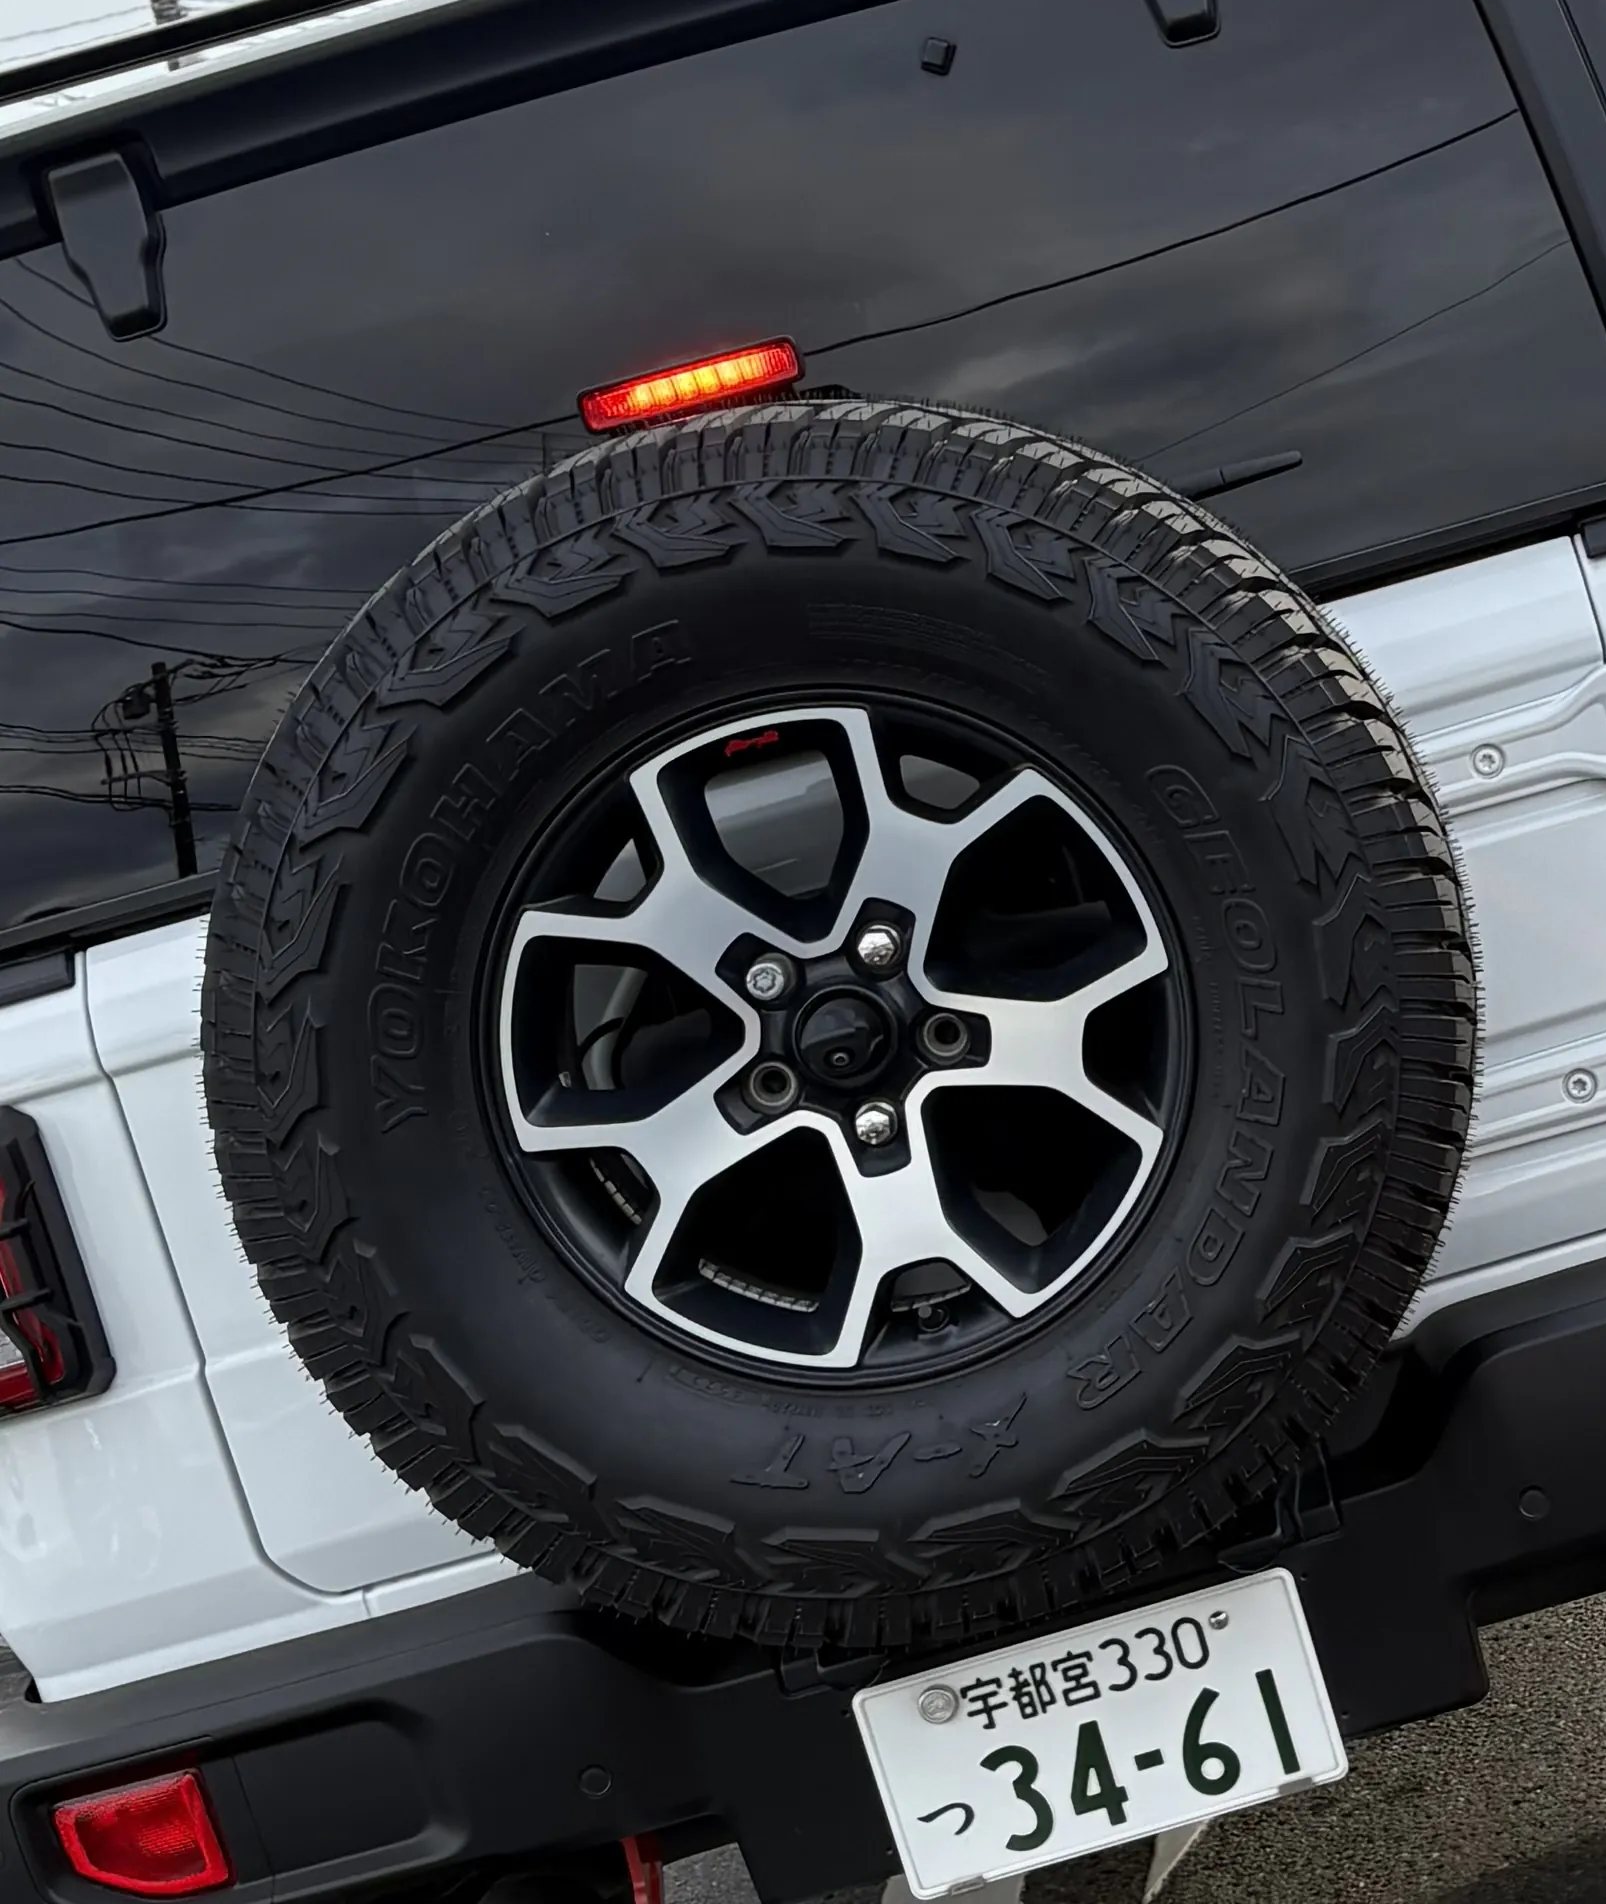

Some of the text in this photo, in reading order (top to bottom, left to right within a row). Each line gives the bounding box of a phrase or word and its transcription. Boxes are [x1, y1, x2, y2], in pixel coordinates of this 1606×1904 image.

[370, 618, 696, 1134] YOKOHAMA
[1066, 763, 1288, 1416] GEOLANDAR
[728, 1390, 1030, 1497] X-AT
[916, 1667, 1302, 1853] つ 34-61
